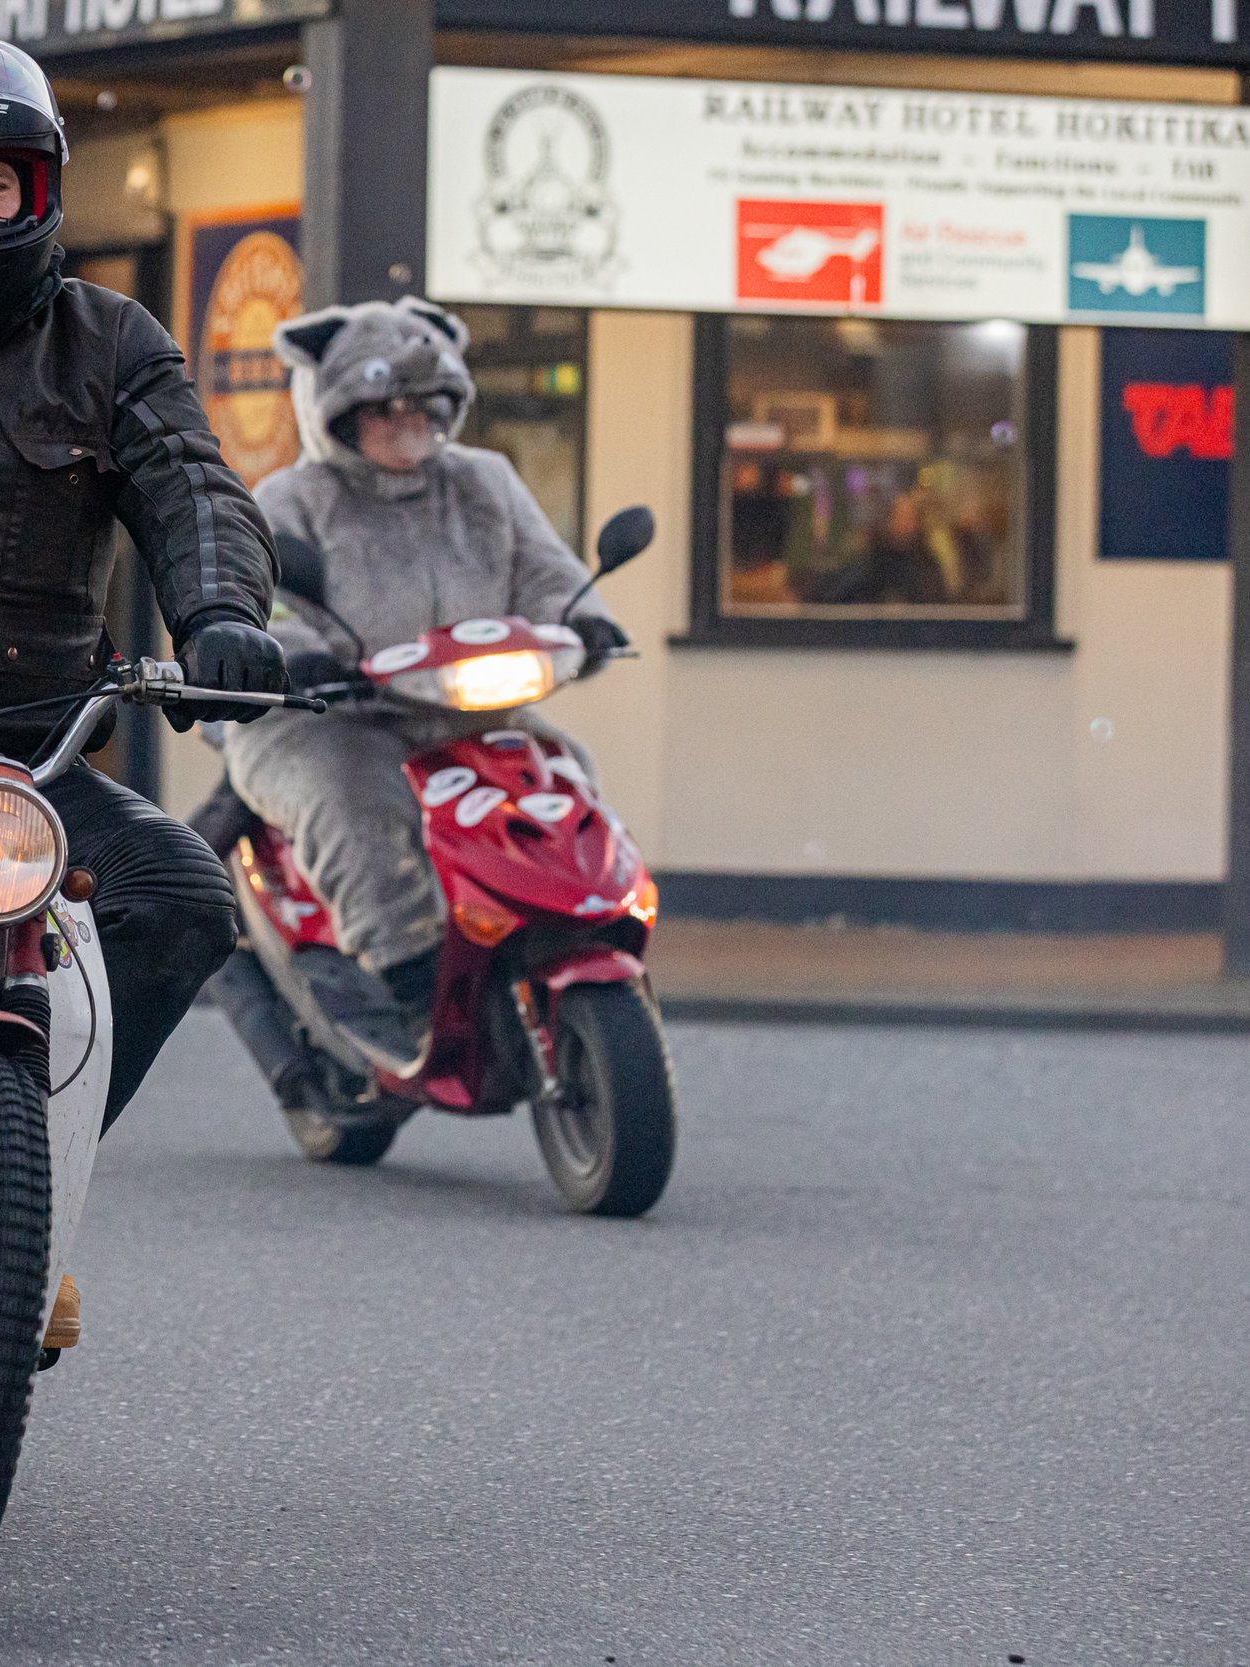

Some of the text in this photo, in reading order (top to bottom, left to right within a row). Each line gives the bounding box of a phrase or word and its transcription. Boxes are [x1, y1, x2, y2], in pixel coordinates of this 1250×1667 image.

[703, 94, 1250, 148] RAILWAY HOTEL HOKITIKA
